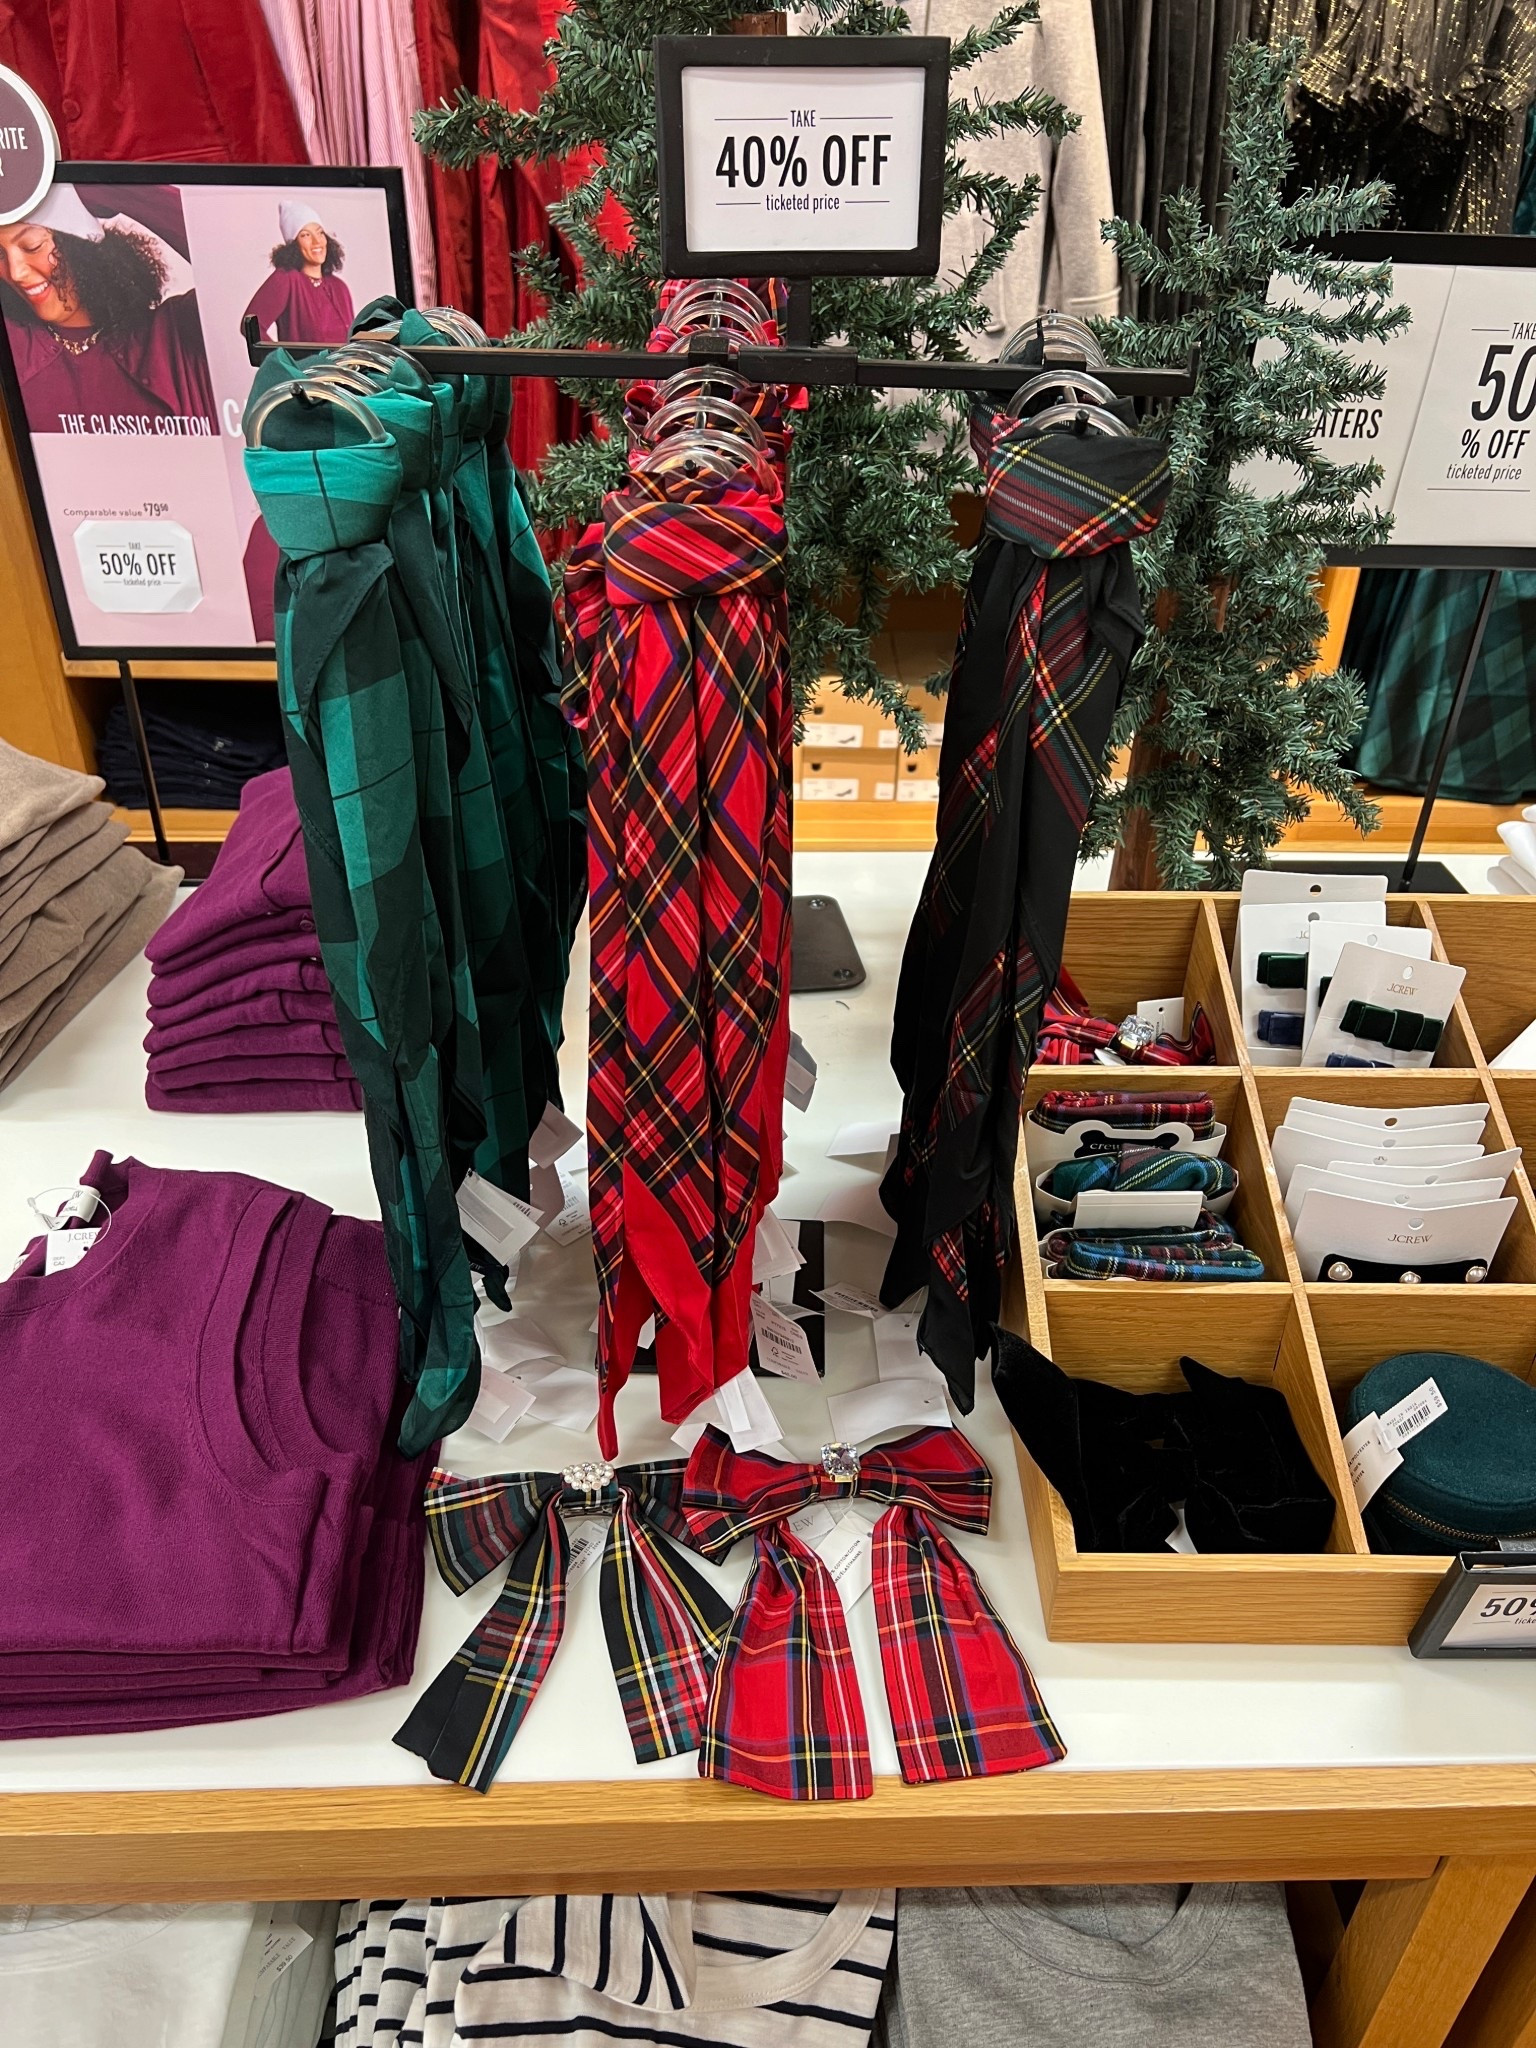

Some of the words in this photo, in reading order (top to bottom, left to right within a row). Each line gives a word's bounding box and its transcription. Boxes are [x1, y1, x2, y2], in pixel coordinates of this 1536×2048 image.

[790, 109, 817, 127] TAKE
[715, 135, 808, 188] 40%
[822, 134, 892, 186] OFF
[765, 193, 810, 211] ticketed
[813, 193, 840, 214] price
[58, 414, 87, 435] THE
[90, 414, 152, 436] CLASSIC
[154, 416, 212, 437] COTTON
[1308, 408, 1384, 438] ATERS
[1461, 428, 1481, 459] %
[1487, 429, 1531, 459] OFF
[1446, 463, 1494, 479] ticketed
[1492, 464, 1522, 484] price
[63, 508, 117, 520] Comparable
[118, 508, 143, 517] value
[99, 553, 142, 576] 50%
[146, 553, 176, 576] OFF
